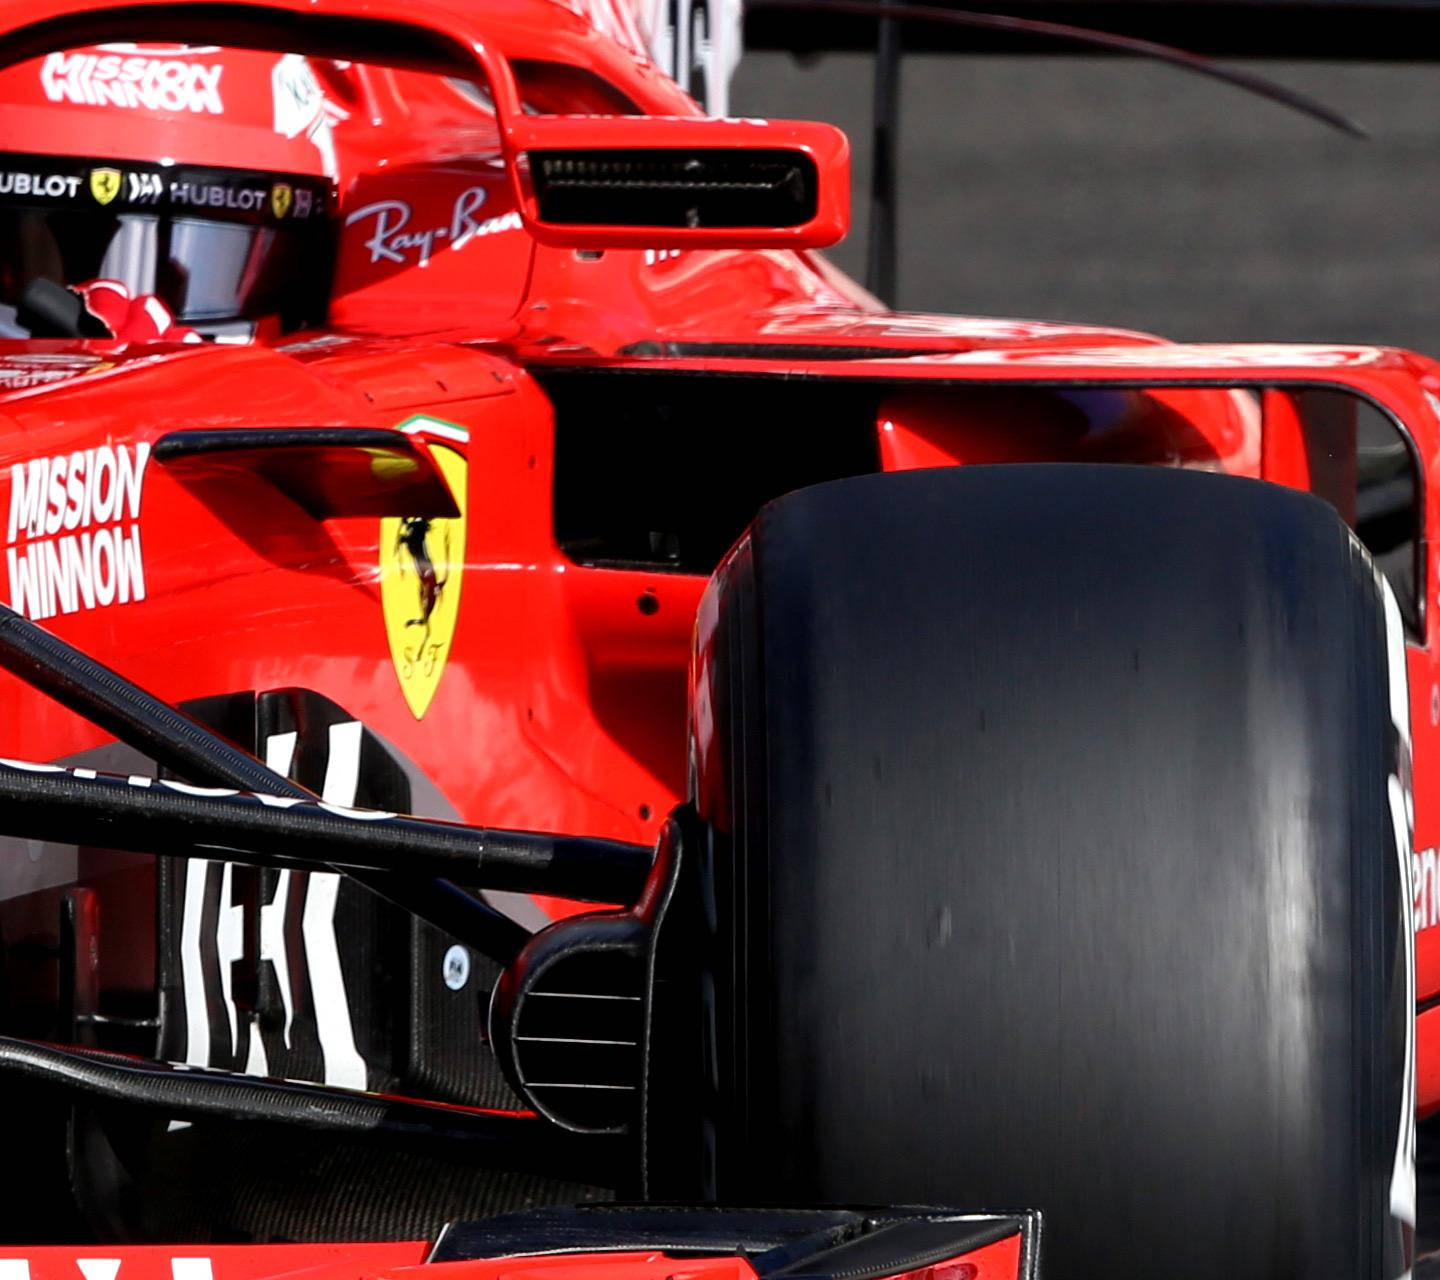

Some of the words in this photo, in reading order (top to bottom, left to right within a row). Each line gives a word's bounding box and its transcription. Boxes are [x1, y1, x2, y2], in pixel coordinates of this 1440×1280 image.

[41, 74, 223, 113] WINNOW
[42, 52, 223, 92] MISSION
[170, 182, 267, 211] HUBLOT
[345, 187, 523, 268] Ray-Ban
[7, 442, 151, 544] MISSION
[6, 523, 146, 621] WINNOW
